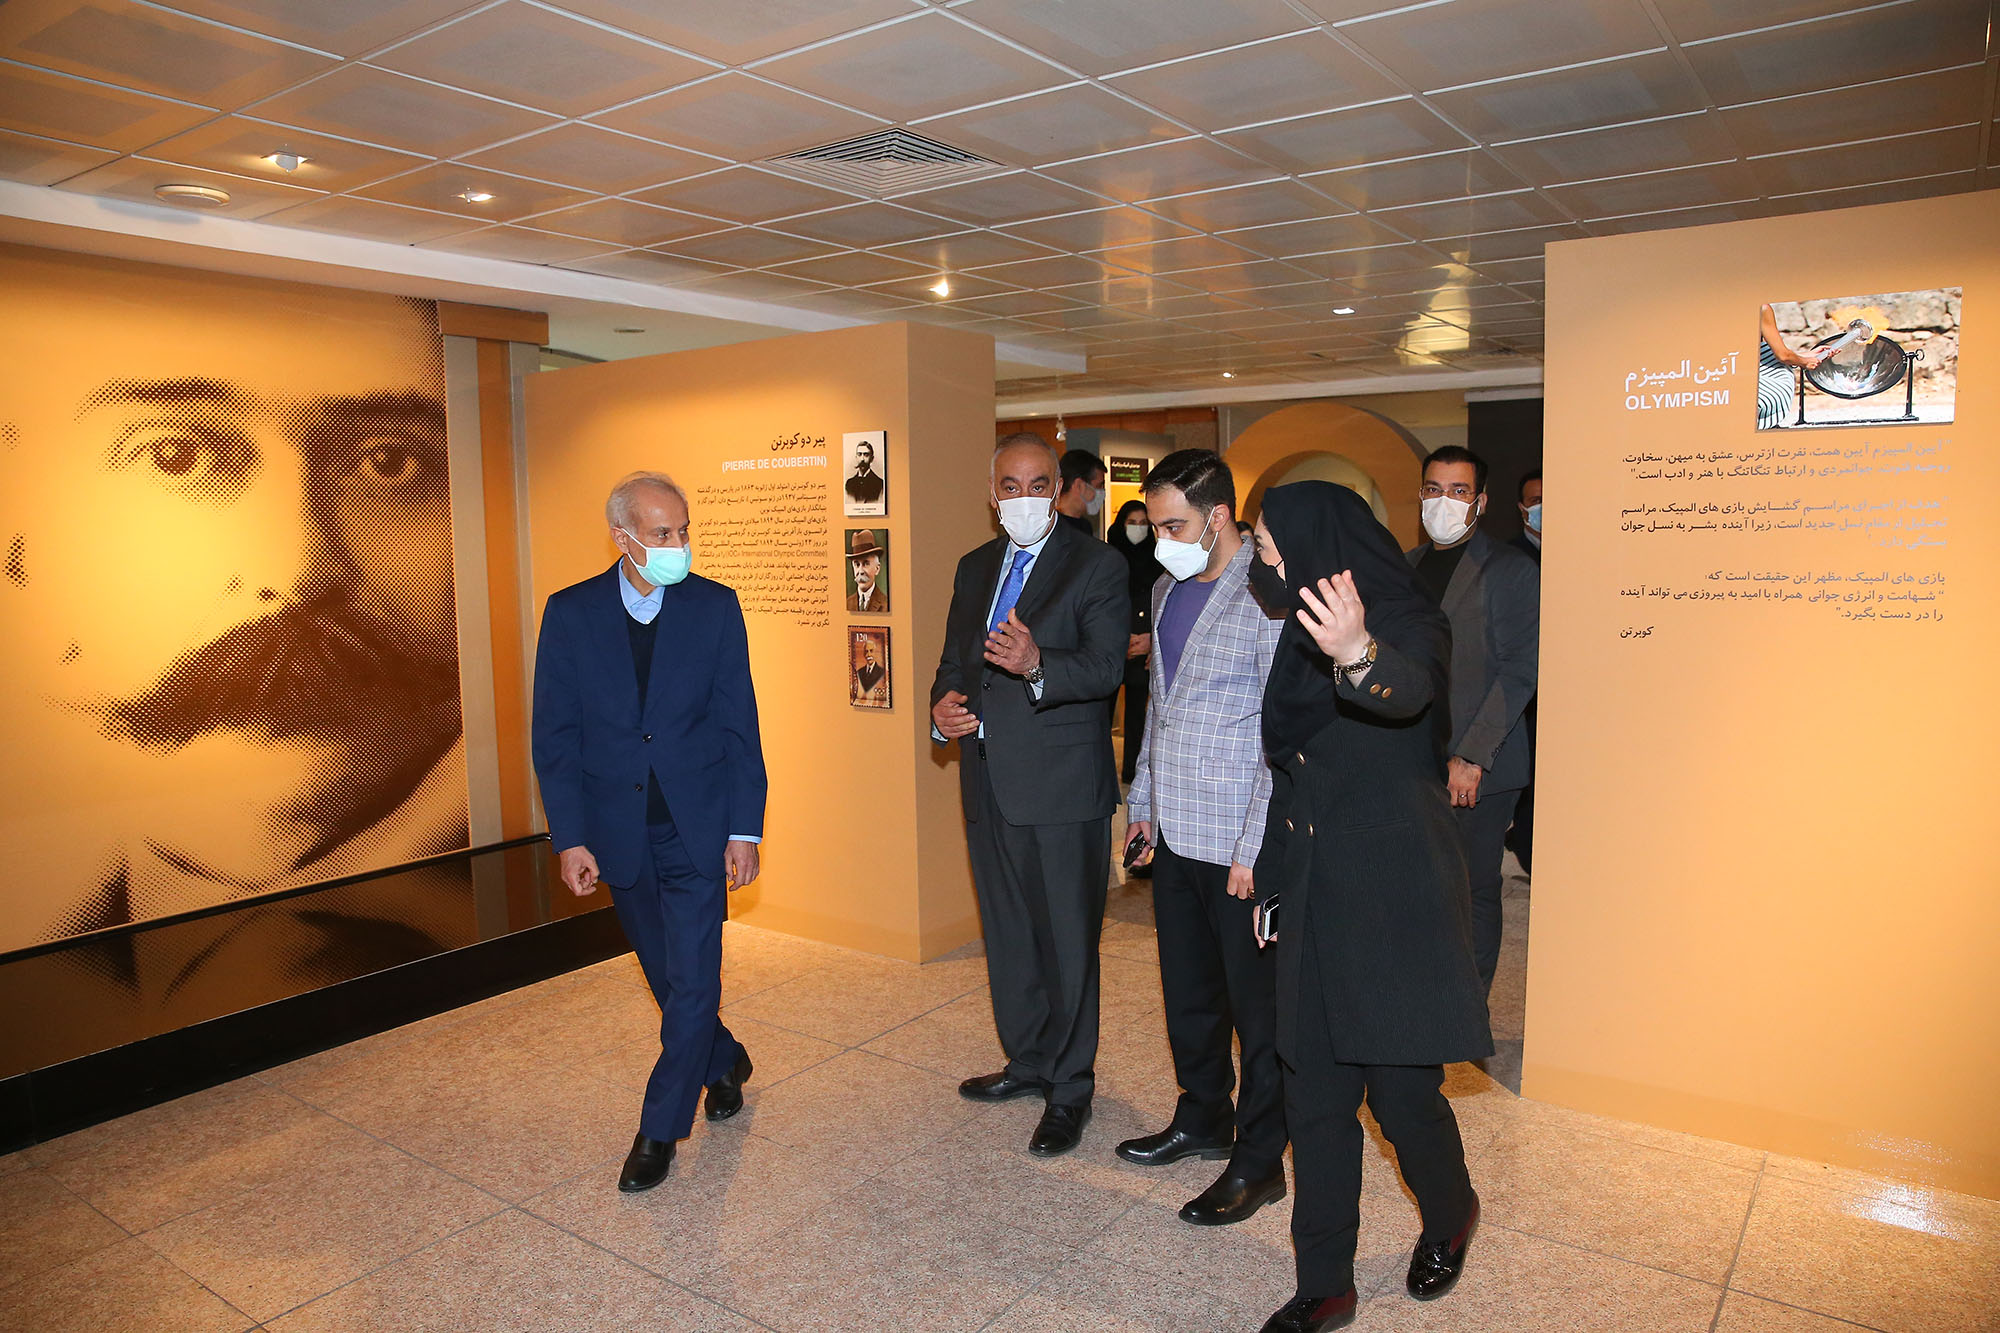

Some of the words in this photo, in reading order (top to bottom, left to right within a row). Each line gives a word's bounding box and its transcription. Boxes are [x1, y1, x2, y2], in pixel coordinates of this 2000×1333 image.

[1693, 351, 1740, 385] آئین
[1624, 359, 1691, 393] المپیزم
[1625, 390, 1729, 410] OLYMPISM
[771, 432, 800, 451] کوبرتن
[801, 435, 811, 448] دو
[813, 436, 826, 448] پیر
[1778, 447, 1807, 460] نفرت
[1843, 441, 1871, 459] آیین
[721, 459, 756, 472] (PIERRE
[757, 458, 770, 469] DE
[771, 455, 827, 469] COUBERTIN)
[1695, 452, 1706, 463] به
[1708, 451, 1734, 463] عشق
[1664, 468, 1686, 481] ادب
[1688, 472, 1694, 480] و
[1696, 470, 1714, 480] هنر
[1716, 467, 1724, 479] با
[1727, 464, 1771, 477] تنگاتنگ
[1774, 465, 1806, 477] ارتباط
[1809, 468, 1815, 477] و
[1621, 503, 1657, 518] مراسم
[1698, 502, 1719, 515] های
[1721, 501, 1745, 514] بازی
[1620, 520, 1646, 533] جوان
[1647, 520, 1674, 533] نسل
[1676, 522, 1686, 532] به
[1688, 521, 1718, 532] بشر
[1722, 516, 1750, 531] آینده
[1751, 519, 1772, 531] زیرا
[1805, 521, 1836, 531] جدید
[1725, 571, 1750, 581] است
[1752, 572, 1790, 583] حقیقت
[1792, 571, 1811, 584] این
[1814, 571, 1842, 585] مظهر
[1891, 571, 1915, 585] های
[1918, 571, 1945, 585] بازی
[1620, 585, 1646, 599] آینده
[1648, 587, 1670, 600] تواند
[1673, 591, 1688, 600] می
[1689, 588, 1724, 601] پیروزی
[1727, 590, 1738, 600] به
[1740, 588, 1762, 601] امید
[1763, 588, 1771, 601] با
[1774, 588, 1803, 602] همراه
[1808, 589, 1840, 603] جوانی
[1843, 590, 1875, 603] انرژی
[1877, 594, 1884, 603] و
[1887, 590, 1936, 604] شهامت
[1879, 610, 1912, 619] دست
[1915, 611, 1930, 621] در
[1933, 609, 1944, 622] را
[856, 633, 868, 642] 120
[1620, 625, 1654, 639] کوبرتن
